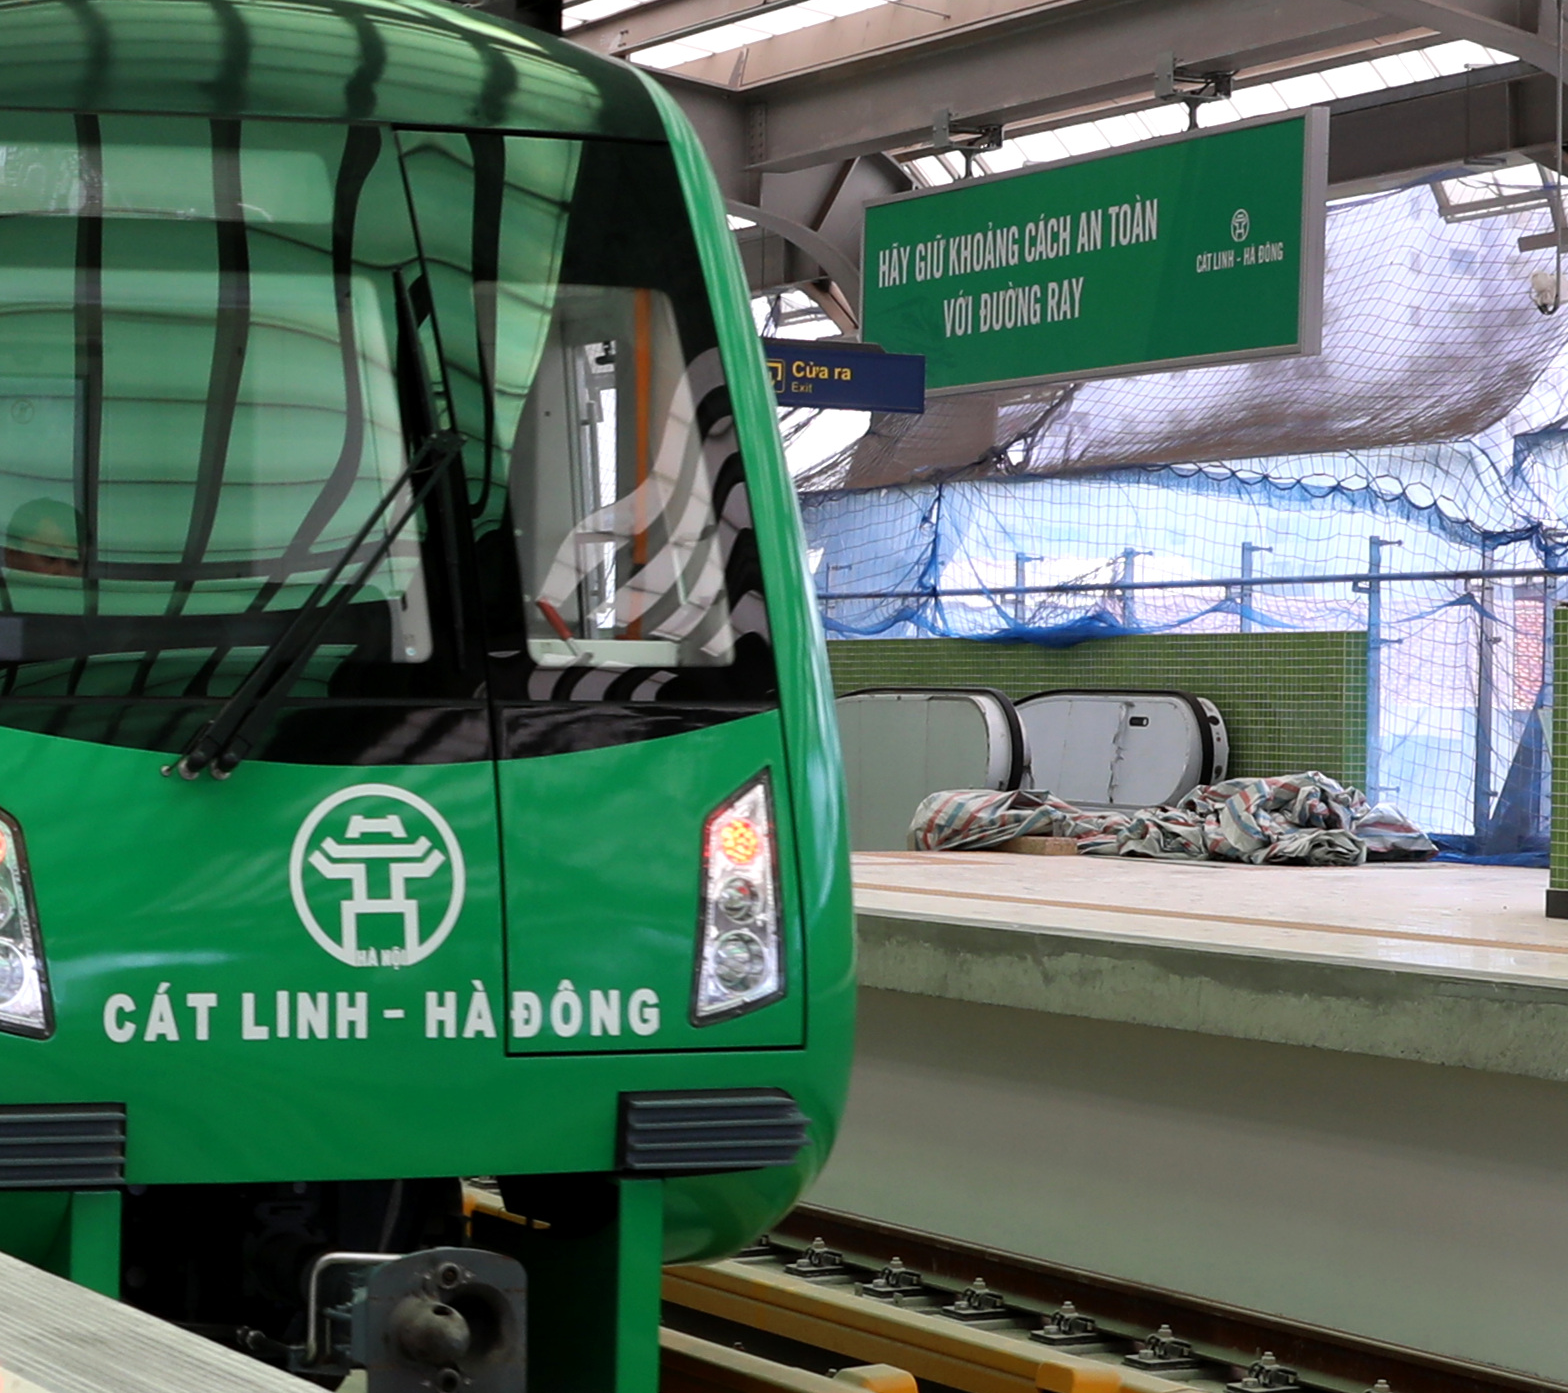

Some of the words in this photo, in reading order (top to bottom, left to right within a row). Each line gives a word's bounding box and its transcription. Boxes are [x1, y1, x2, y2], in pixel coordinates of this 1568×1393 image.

[878, 242, 910, 288] HÃY
[915, 234, 946, 282] GIỮ
[949, 221, 1019, 277] KHOẢNG
[1024, 213, 1071, 263] CÁCH
[1076, 208, 1102, 254] AN
[1108, 194, 1158, 247] TOÀN
[1196, 251, 1212, 274] CÁT
[1213, 249, 1235, 270] LINH
[1258, 241, 1284, 265] ĐÔNG
[943, 290, 972, 338] VỚI
[979, 281, 1041, 333] ĐƯỜNG
[1047, 277, 1084, 323] RAY
[791, 381, 813, 393] Exit
[792, 360, 829, 379] Cửa
[834, 367, 851, 380] ra
[102, 981, 218, 1043] CÁT
[240, 990, 369, 1041] LINH
[424, 979, 498, 1039] HÀ
[511, 978, 661, 1038] ĐÔNG
